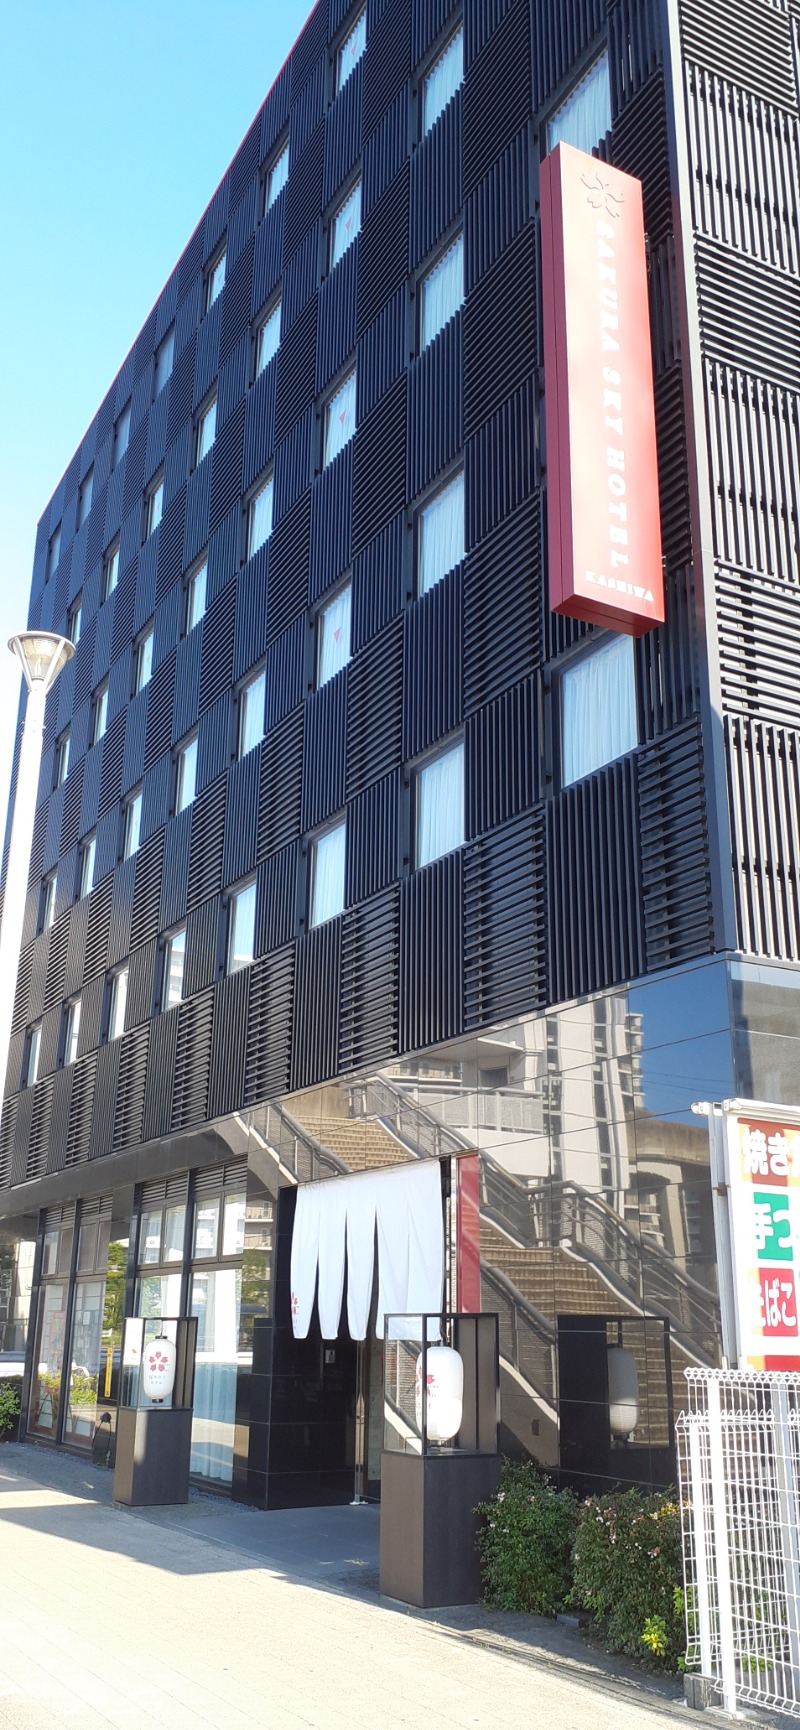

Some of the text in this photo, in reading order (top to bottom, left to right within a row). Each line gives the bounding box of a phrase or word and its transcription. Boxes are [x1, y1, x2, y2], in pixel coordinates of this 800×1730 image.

[597, 220, 629, 568] SAKURA SKY HOTEL
[586, 570, 654, 602] KASHIWA
